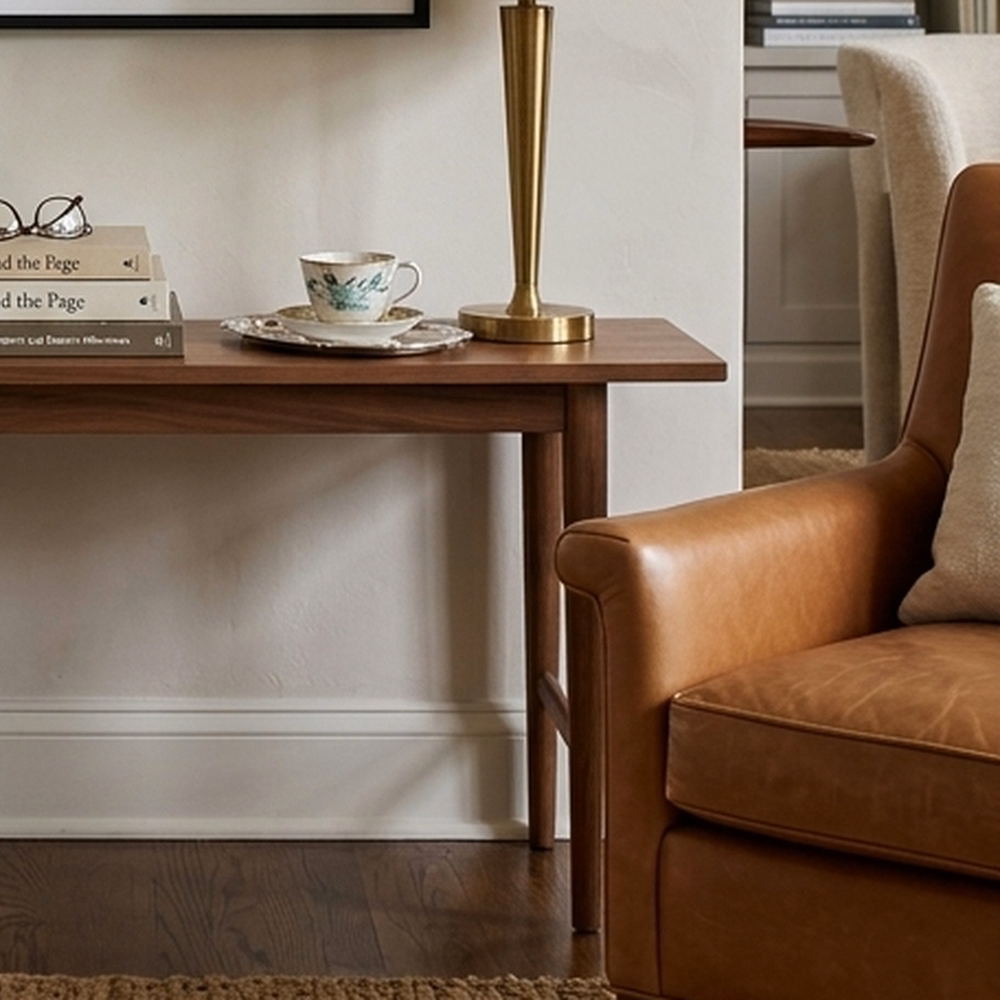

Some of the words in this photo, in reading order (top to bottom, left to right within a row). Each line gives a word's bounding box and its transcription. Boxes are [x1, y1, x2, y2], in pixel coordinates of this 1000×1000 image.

[16, 254, 41, 271] the
[17, 291, 42, 309] the
[47, 291, 86, 314] Page
